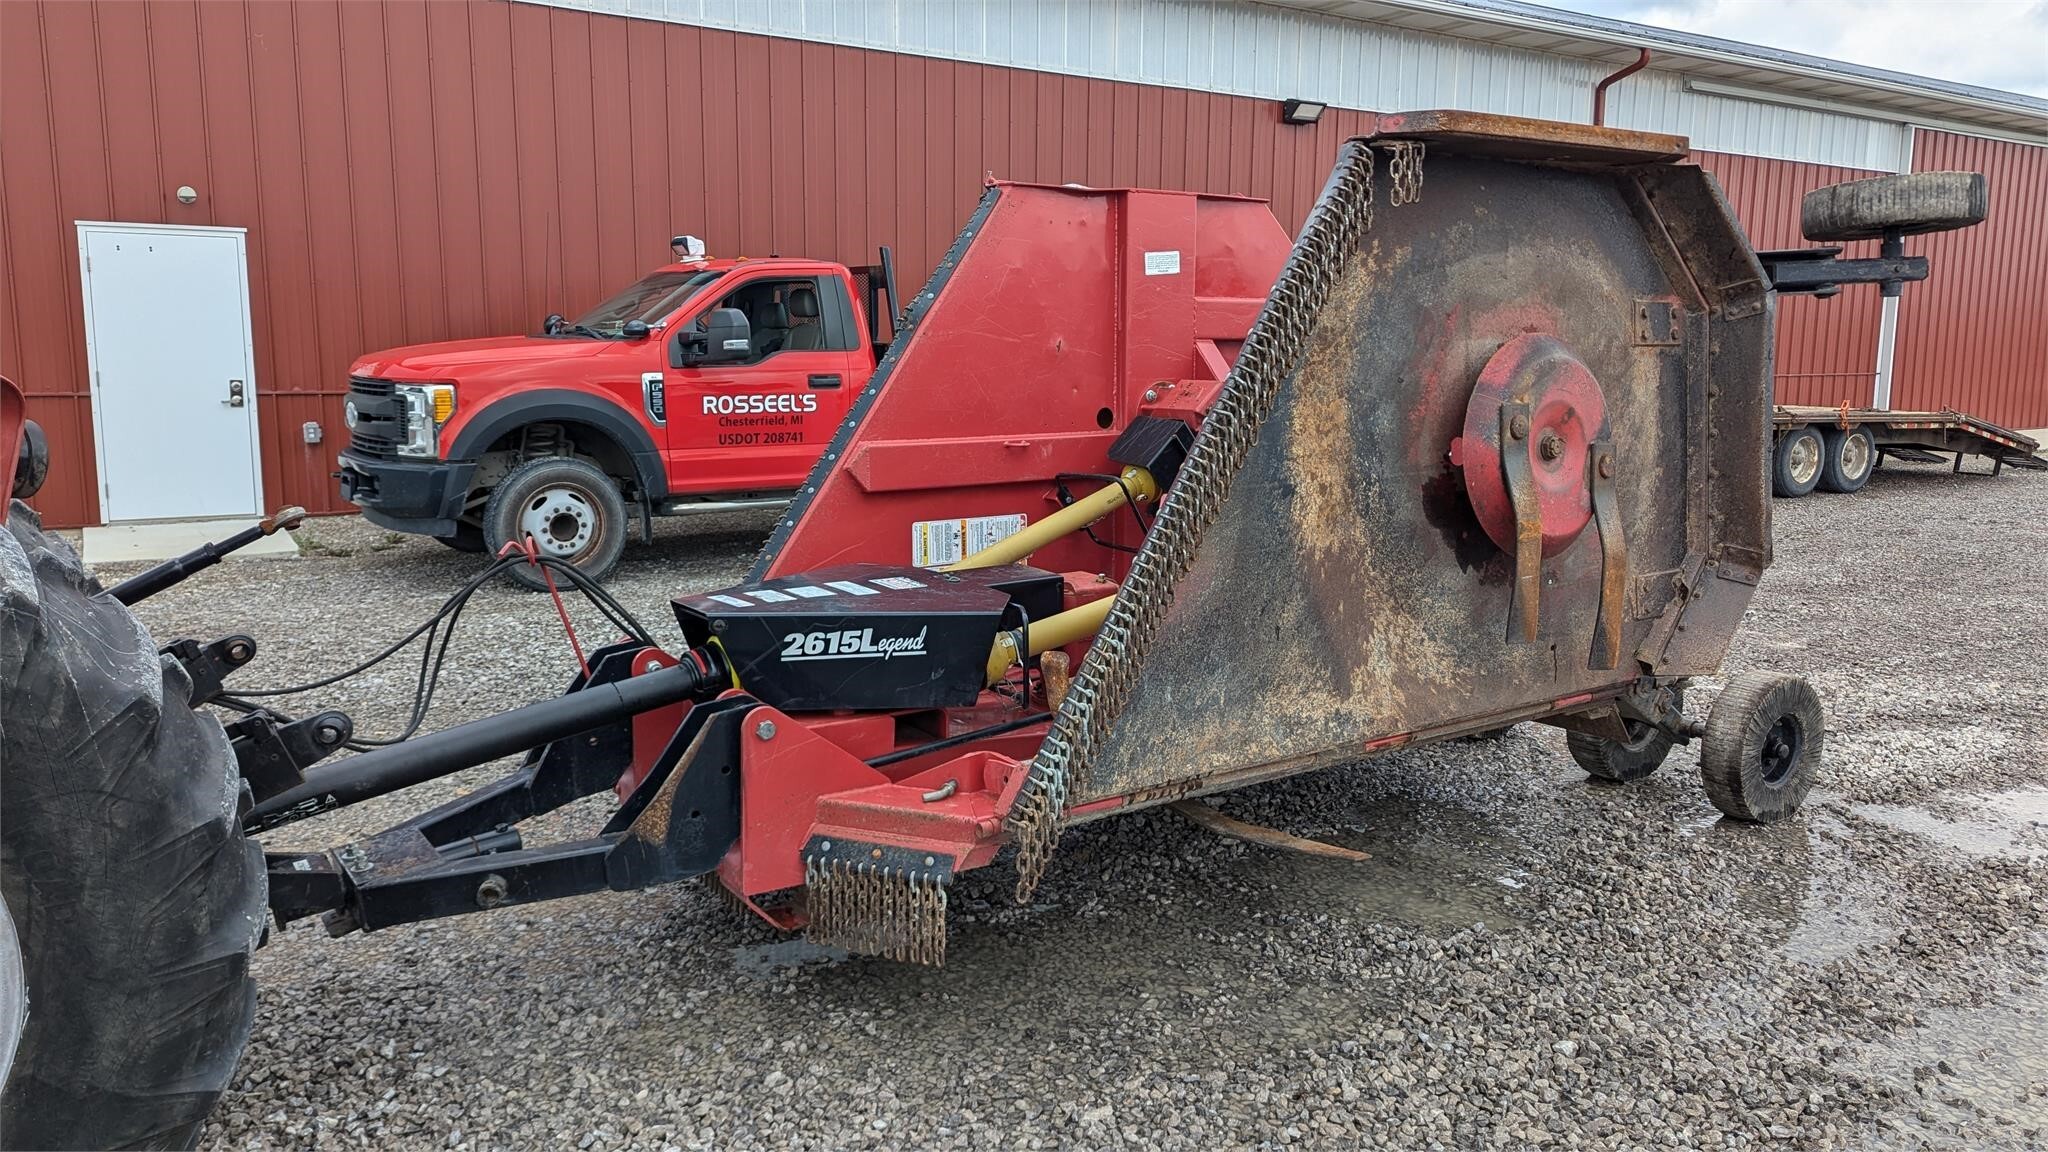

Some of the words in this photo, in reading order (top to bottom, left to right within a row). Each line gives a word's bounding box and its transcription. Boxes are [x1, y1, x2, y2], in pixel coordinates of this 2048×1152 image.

[702, 394, 817, 415] ROSSEEL'S
[718, 416, 788, 428] Chesterfield,
[790, 415, 803, 425] MI
[718, 433, 761, 445] USDOT
[764, 432, 804, 444] 208741
